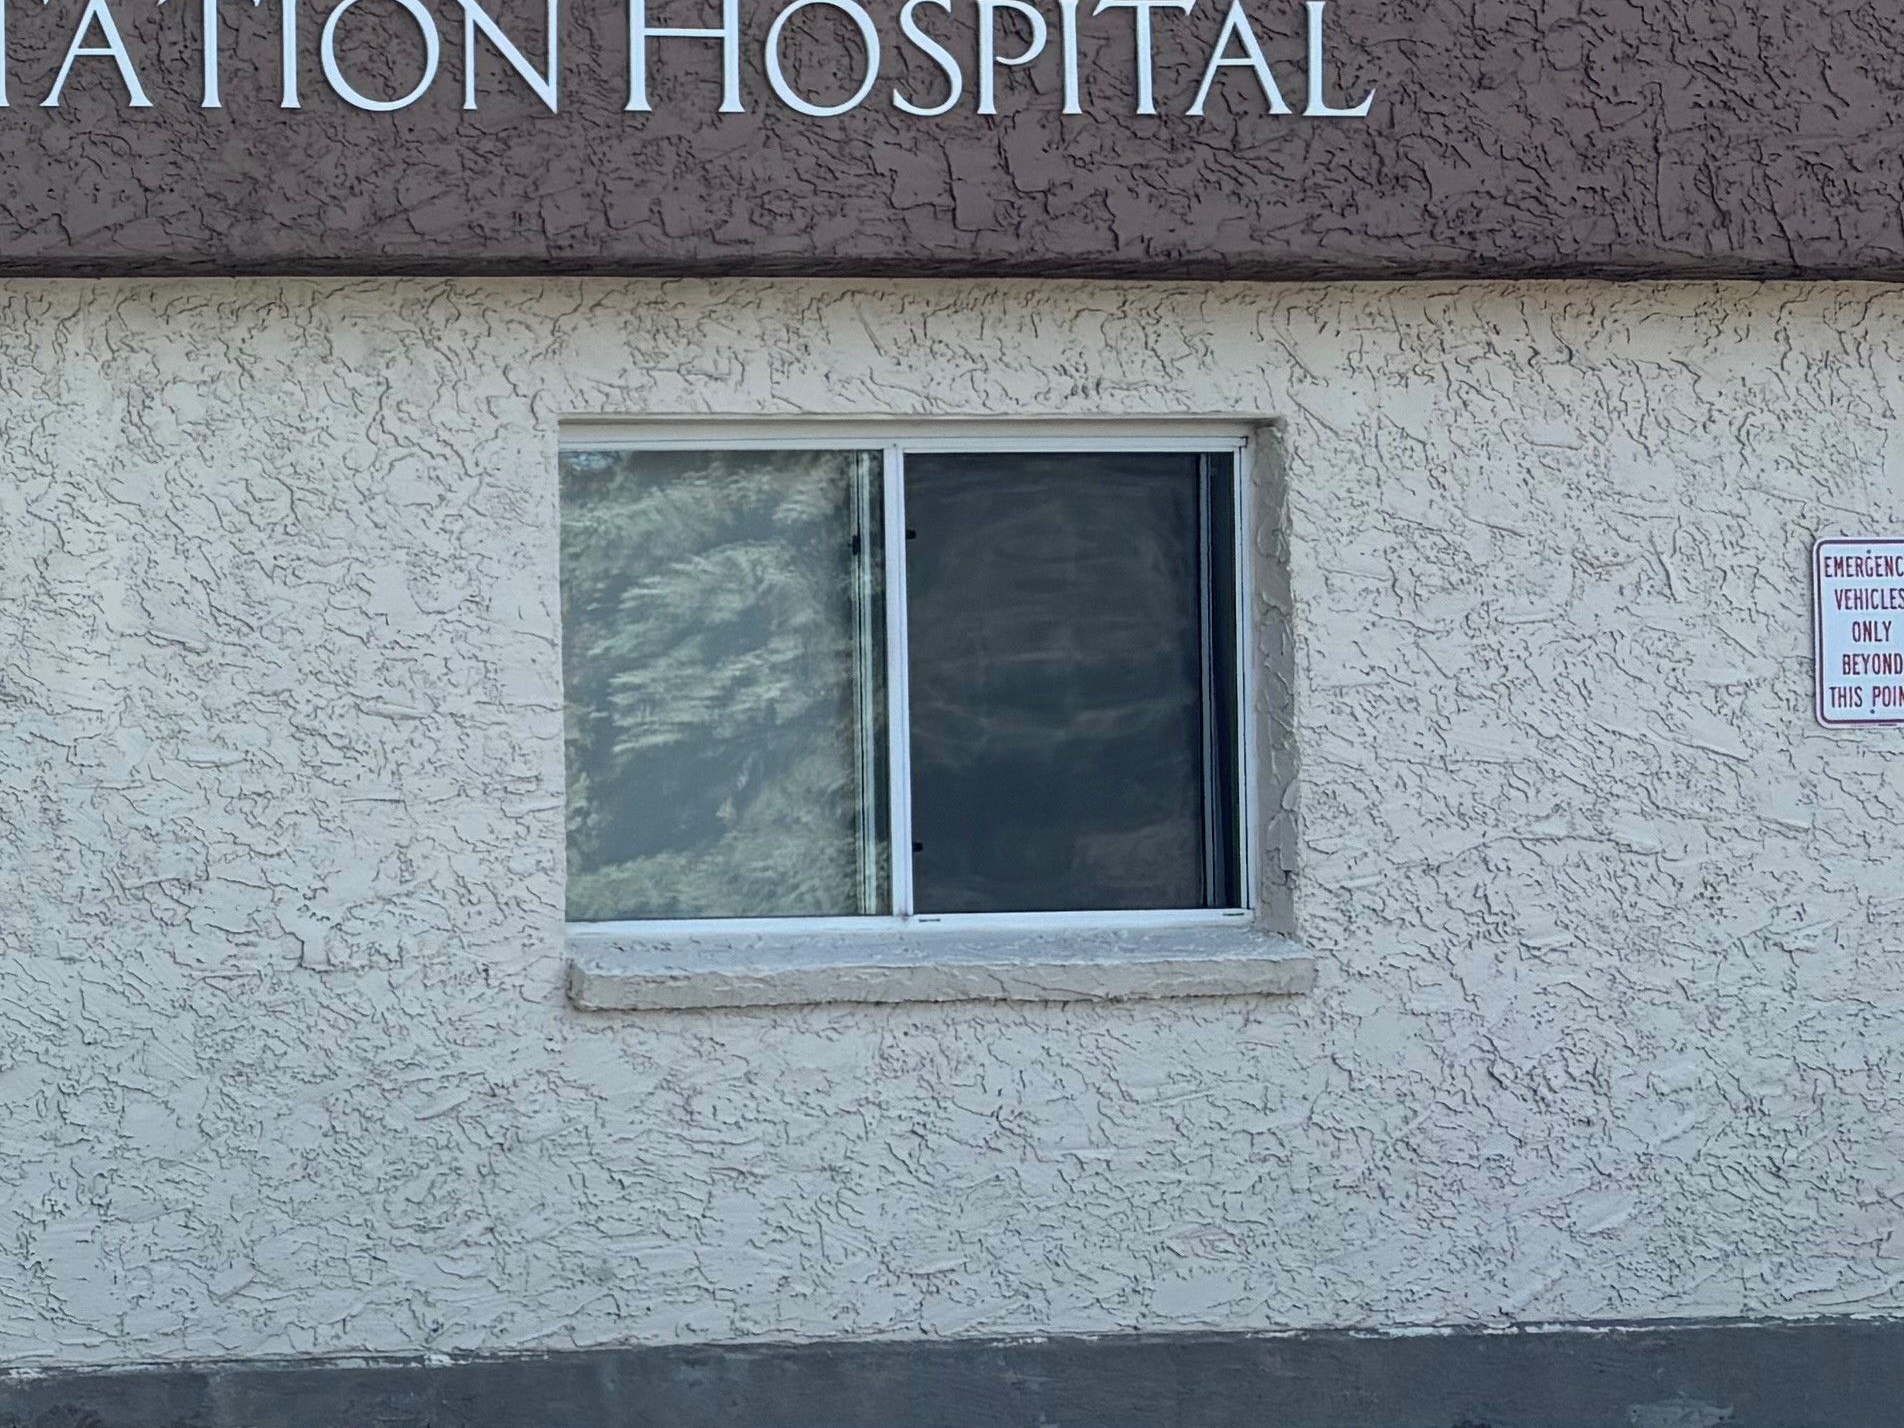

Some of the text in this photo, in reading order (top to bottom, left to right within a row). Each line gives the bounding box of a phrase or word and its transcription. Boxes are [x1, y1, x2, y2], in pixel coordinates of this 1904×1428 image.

[1851, 621, 1892, 642] ONLY
[1842, 653, 1903, 675] BEYOND
[1829, 686, 1863, 708] THIS
